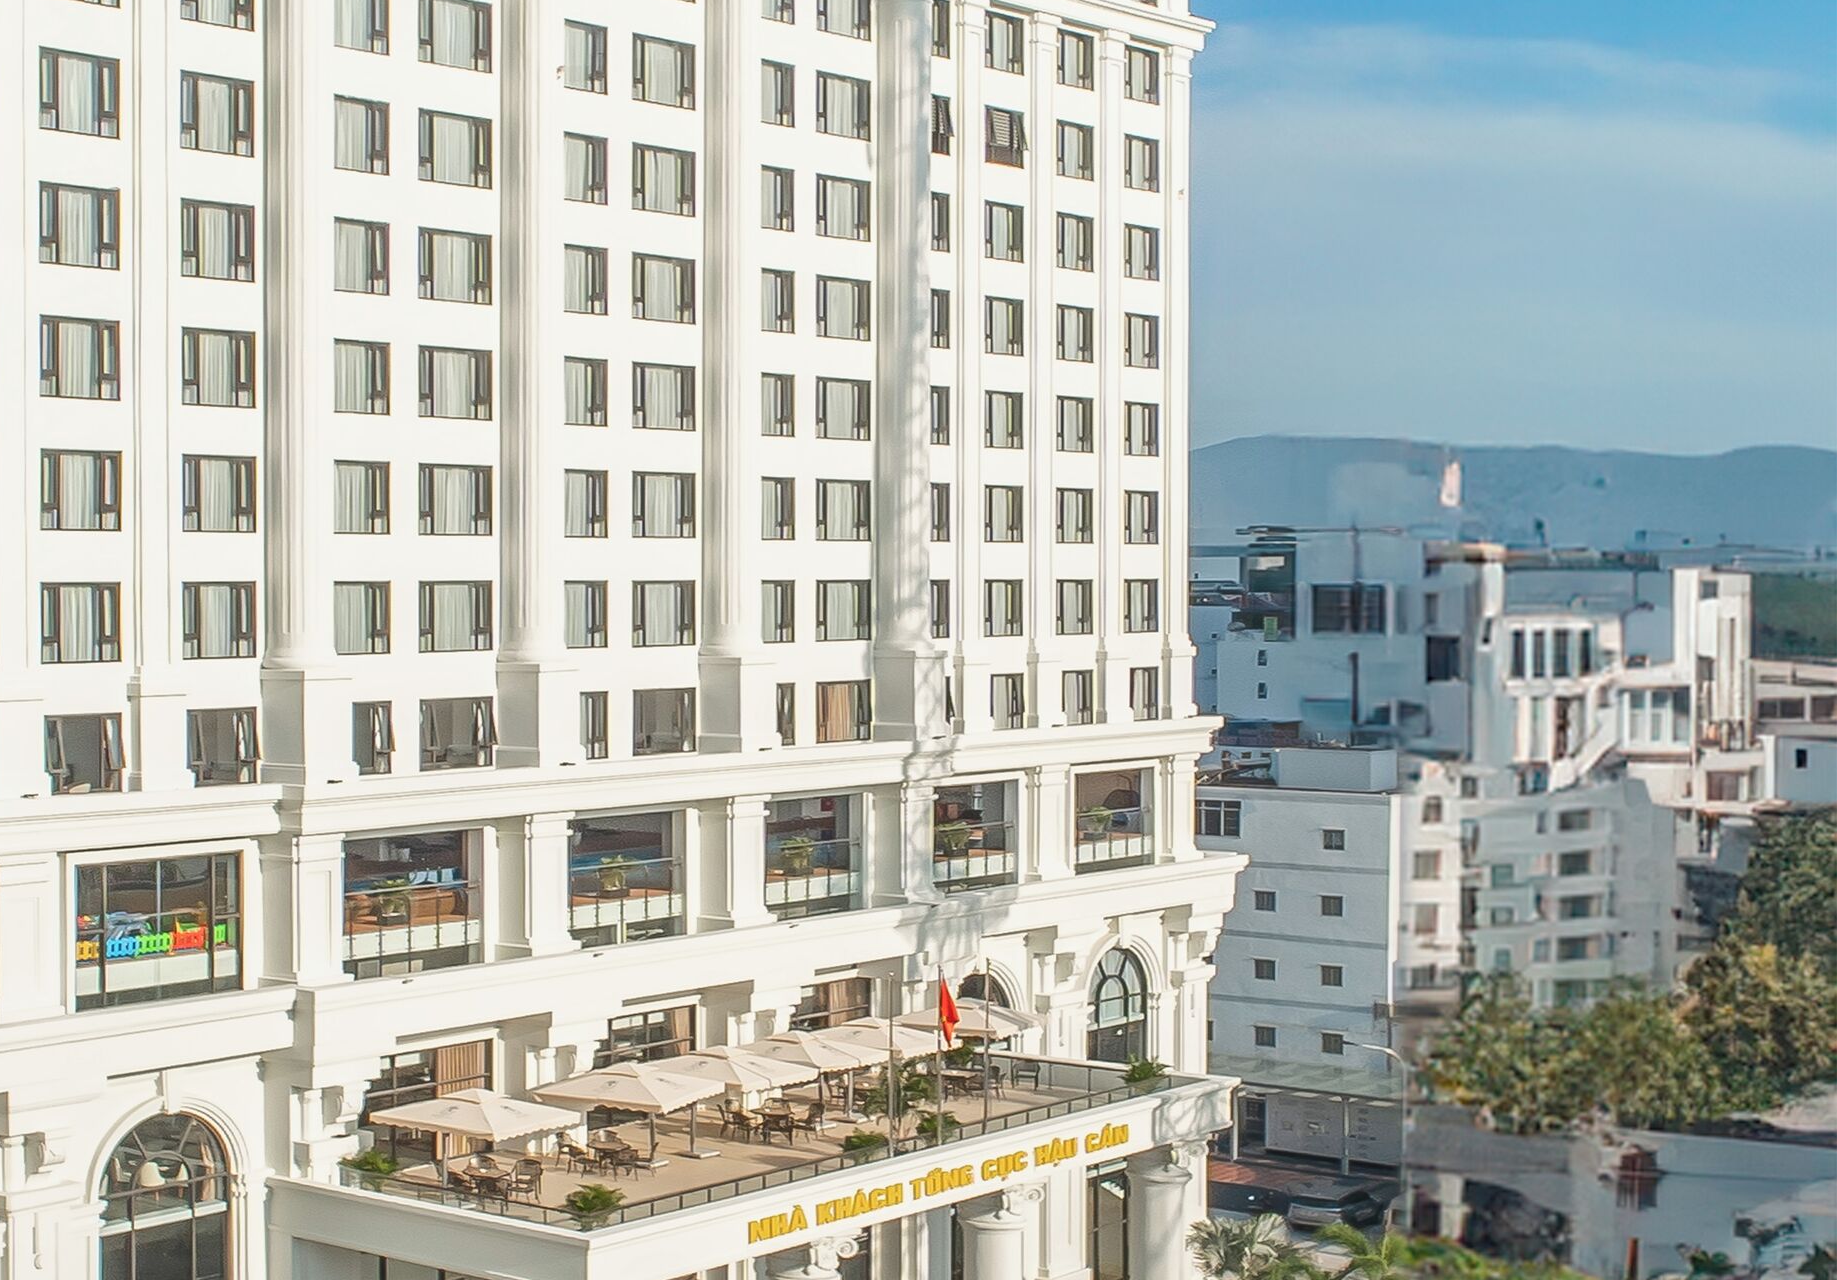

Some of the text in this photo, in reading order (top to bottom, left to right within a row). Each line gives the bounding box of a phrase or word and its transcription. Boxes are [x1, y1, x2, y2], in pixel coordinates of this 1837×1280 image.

[748, 1204, 808, 1244] NHÀ
[815, 1184, 904, 1226] KHÁCH
[909, 1164, 975, 1201] TỔNG
[981, 1150, 1029, 1181] CỤC
[1034, 1137, 1078, 1167] HẬU
